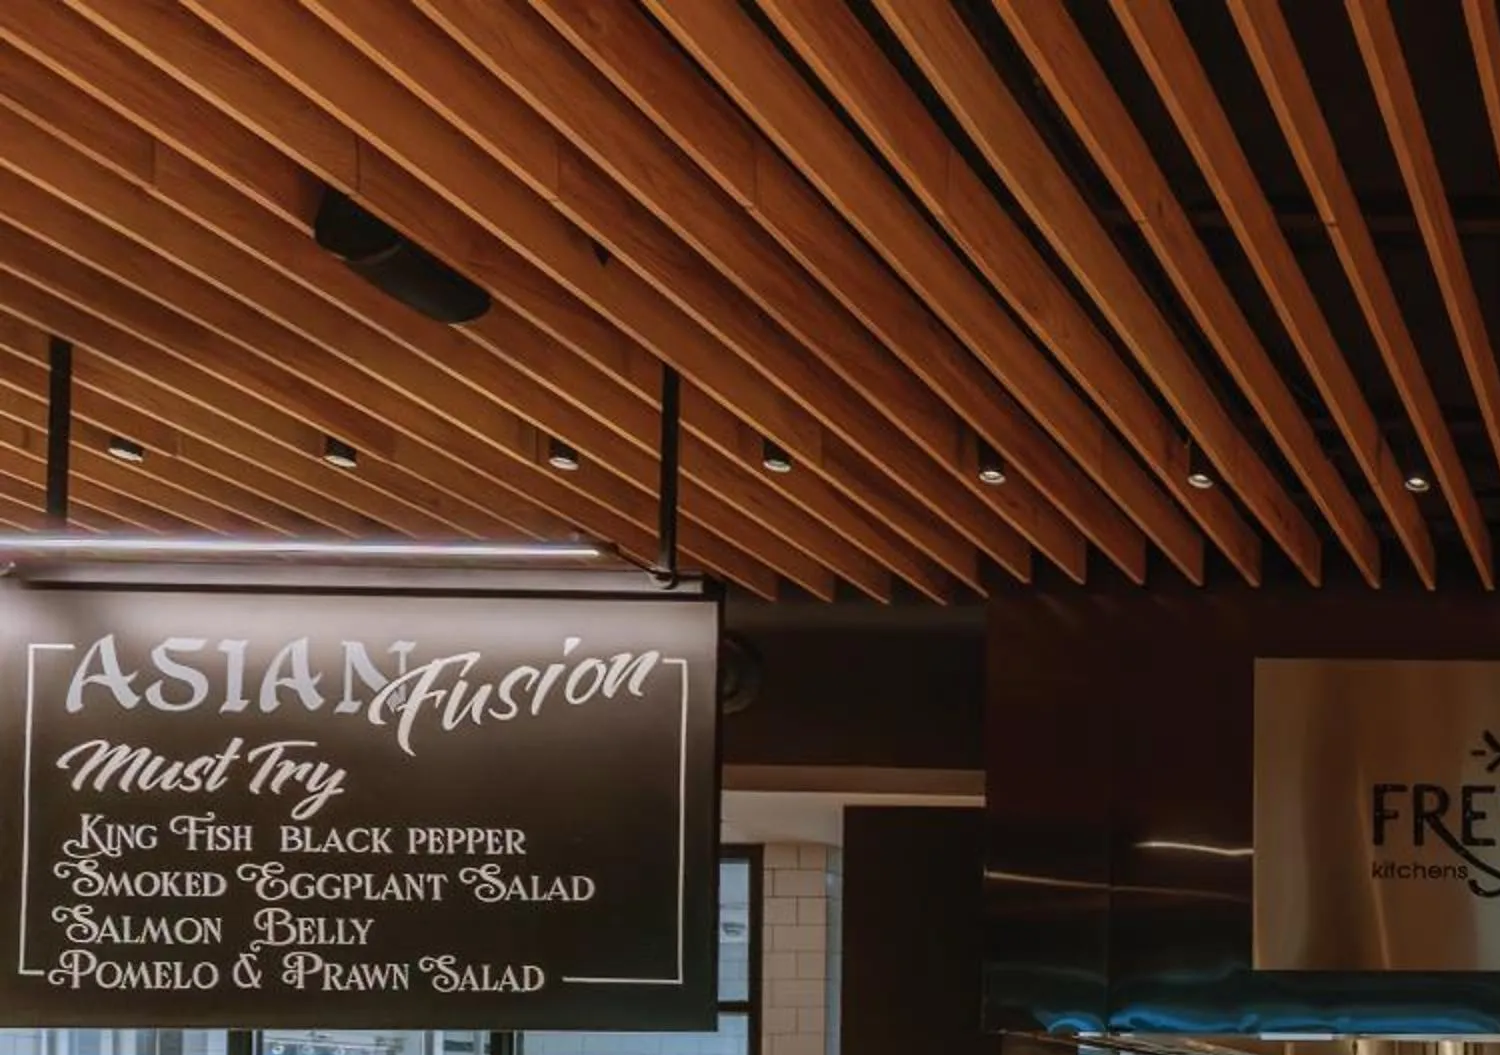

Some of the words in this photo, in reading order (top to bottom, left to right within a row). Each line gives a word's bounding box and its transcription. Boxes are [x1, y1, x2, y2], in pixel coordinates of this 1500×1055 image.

[66, 633, 416, 713] ASIAN
[368, 637, 661, 755] Fusion
[56, 737, 244, 793] Must
[247, 740, 348, 821] Try
[63, 813, 158, 859] KING
[169, 812, 252, 851] FISH
[279, 826, 392, 853] BLACK
[407, 827, 527, 855] PEPPER
[53, 859, 228, 897] SMOKED
[236, 861, 449, 901] EGGPLANT
[459, 862, 596, 902] SALAD
[1371, 861, 1469, 880] kitchens
[52, 904, 223, 943] SALMON
[250, 907, 375, 952] BELLY
[48, 949, 219, 989] POMELO
[232, 953, 264, 989] &
[281, 951, 410, 991] PRAWN
[418, 954, 545, 993] SALAD
